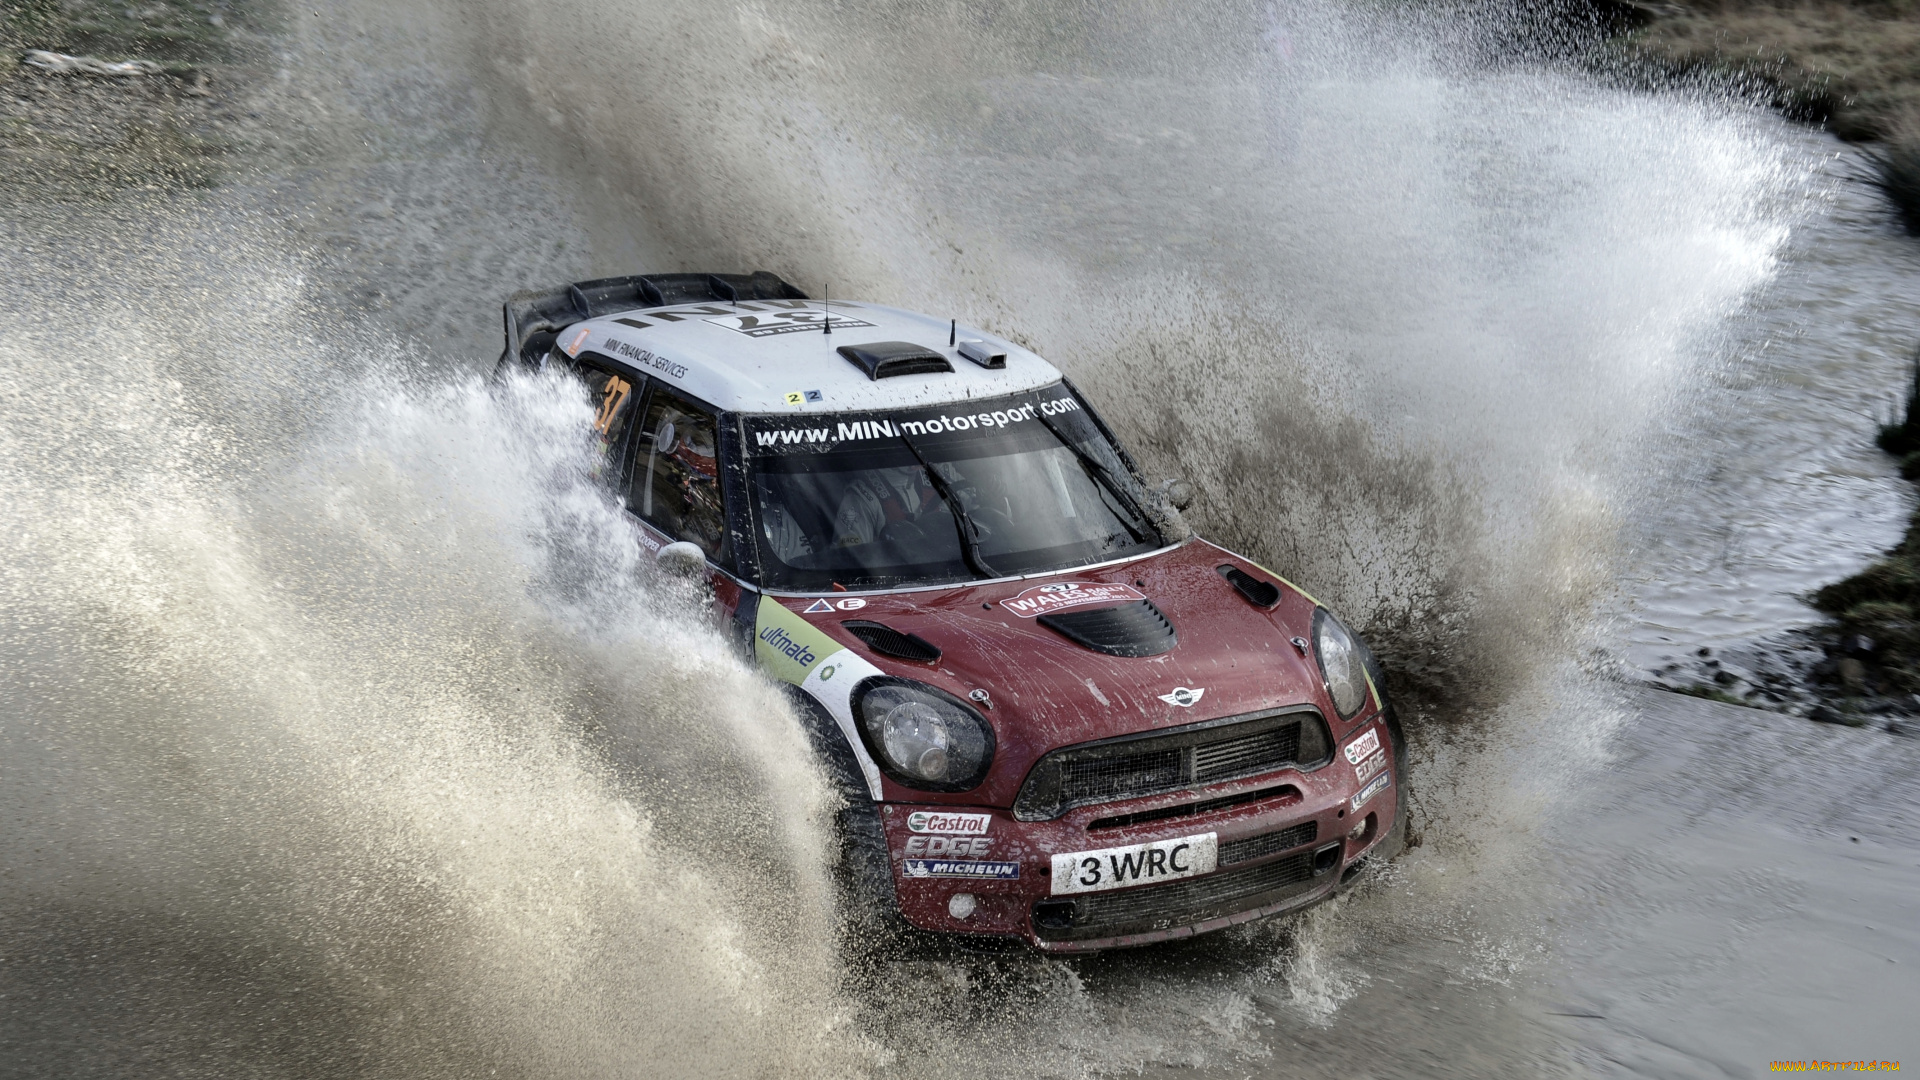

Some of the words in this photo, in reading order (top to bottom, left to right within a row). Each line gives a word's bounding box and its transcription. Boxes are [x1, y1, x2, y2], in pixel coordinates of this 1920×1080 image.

[738, 311, 841, 330] 37
[603, 338, 621, 352] MINI
[620, 343, 655, 367] FINANCIAL
[652, 357, 688, 379] SERVICES
[594, 375, 631, 435] 37
[788, 394, 800, 403] 2
[808, 391, 820, 400] 2
[638, 535, 660, 552] COOPER
[843, 600, 859, 608] E
[1009, 589, 1089, 611] WALES
[759, 626, 816, 667] ultimate
[1353, 733, 1378, 758] Castrol
[1355, 747, 1387, 787] EDGE
[1361, 773, 1389, 799] MICHELIN
[927, 815, 985, 831] Castrol
[904, 835, 994, 857] EDGE
[932, 863, 1014, 875] MICHELIN
[1079, 857, 1102, 886] 3
[1110, 843, 1189, 882] WRC
